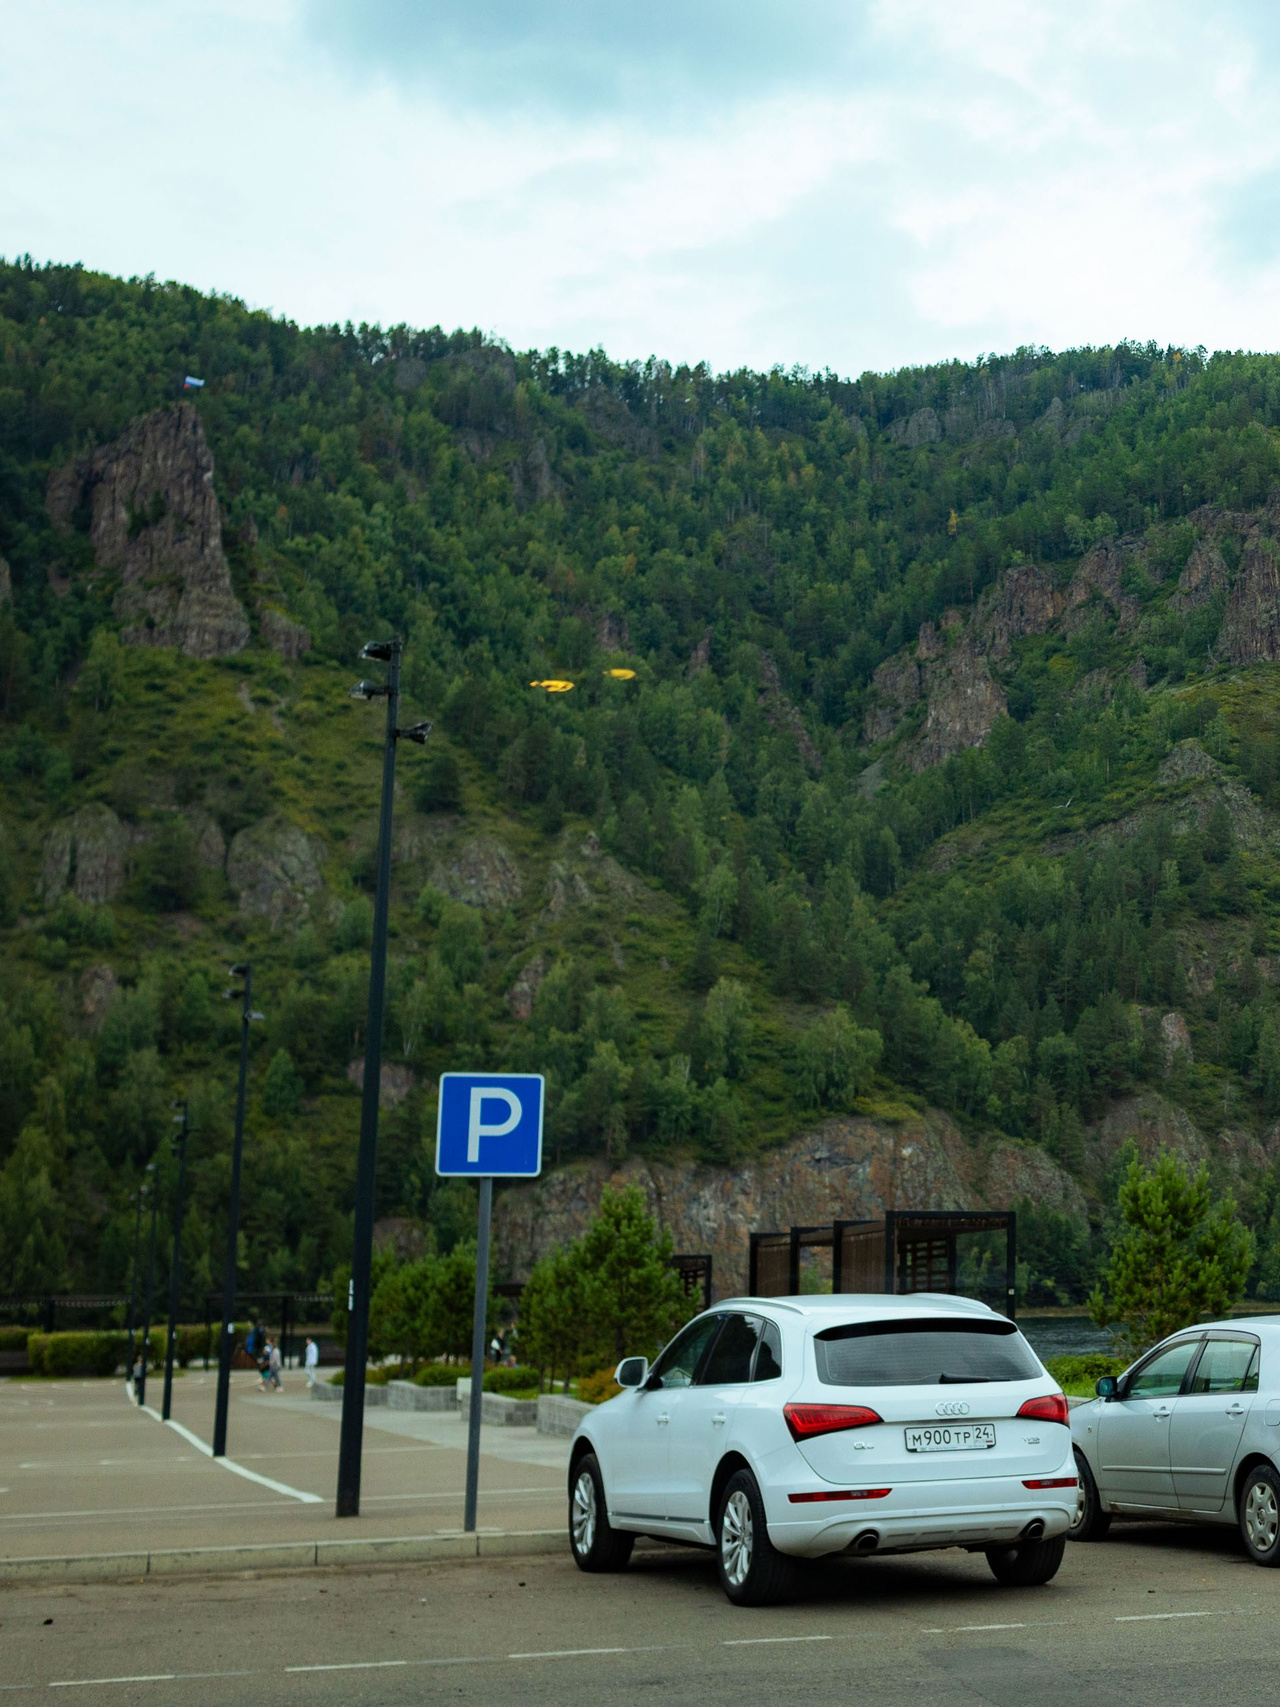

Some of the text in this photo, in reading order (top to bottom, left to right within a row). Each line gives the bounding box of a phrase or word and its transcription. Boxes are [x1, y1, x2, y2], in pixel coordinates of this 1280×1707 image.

[467, 1087, 522, 1163] P
[912, 1427, 989, 1446] М900ТР 24
